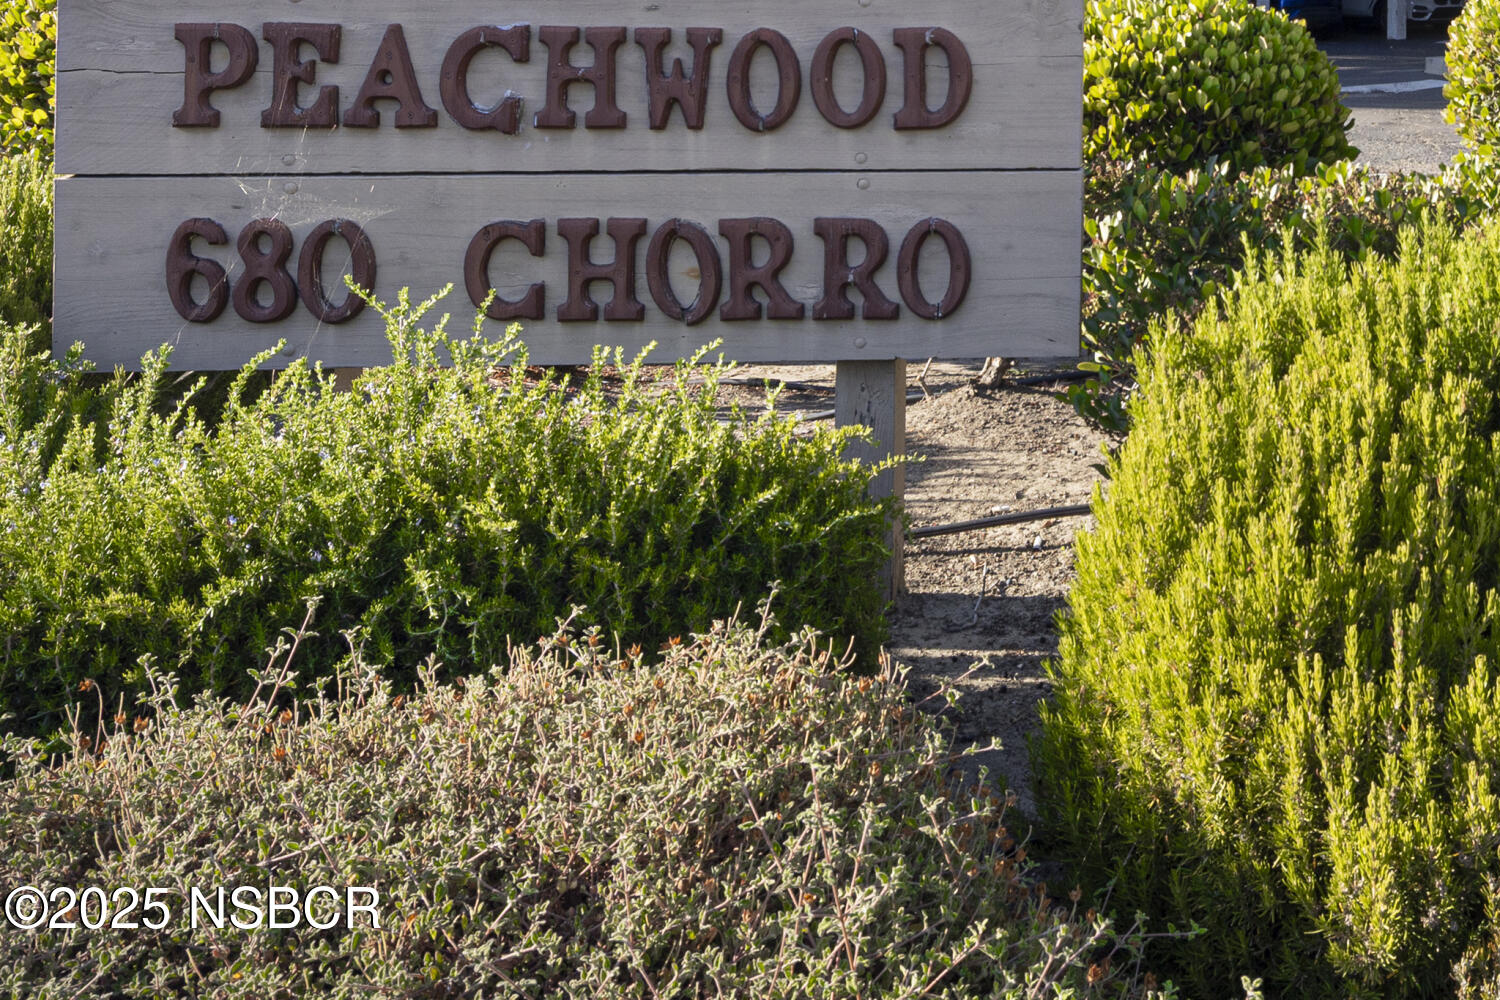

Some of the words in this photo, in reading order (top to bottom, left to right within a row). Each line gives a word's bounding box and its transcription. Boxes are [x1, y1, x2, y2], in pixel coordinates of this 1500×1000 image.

[171, 22, 974, 136] PEACHWOOD
[165, 217, 377, 325] 680
[463, 217, 972, 326] CHORRO
